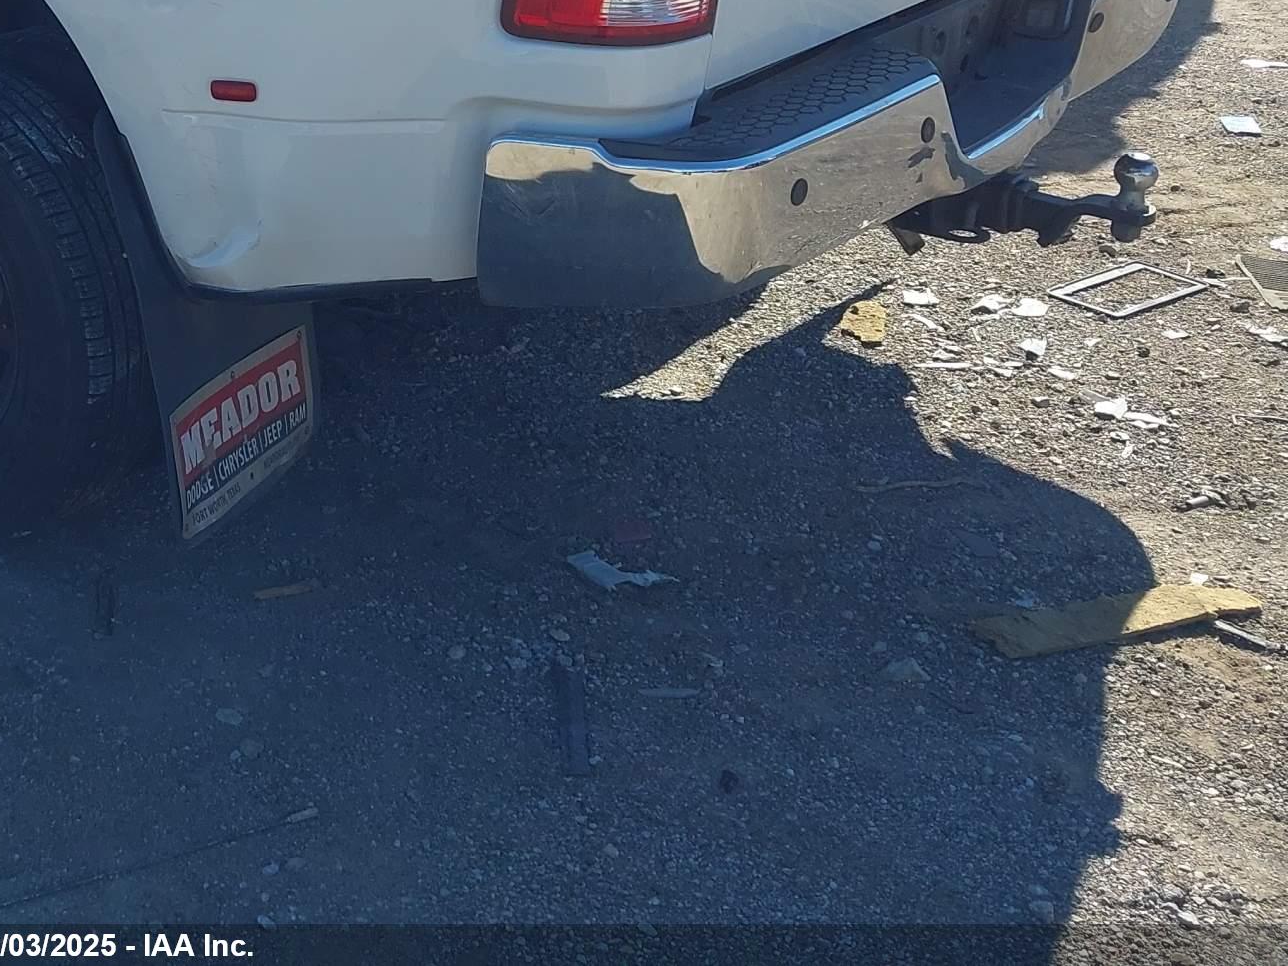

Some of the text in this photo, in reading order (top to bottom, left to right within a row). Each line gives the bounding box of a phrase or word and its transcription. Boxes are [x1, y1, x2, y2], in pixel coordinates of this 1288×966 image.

[181, 360, 301, 475] MEADOR
[186, 476, 214, 509] DODGE
[218, 440, 258, 481] CHRYSLER
[264, 421, 283, 447] JEEP
[289, 402, 307, 428] RAM
